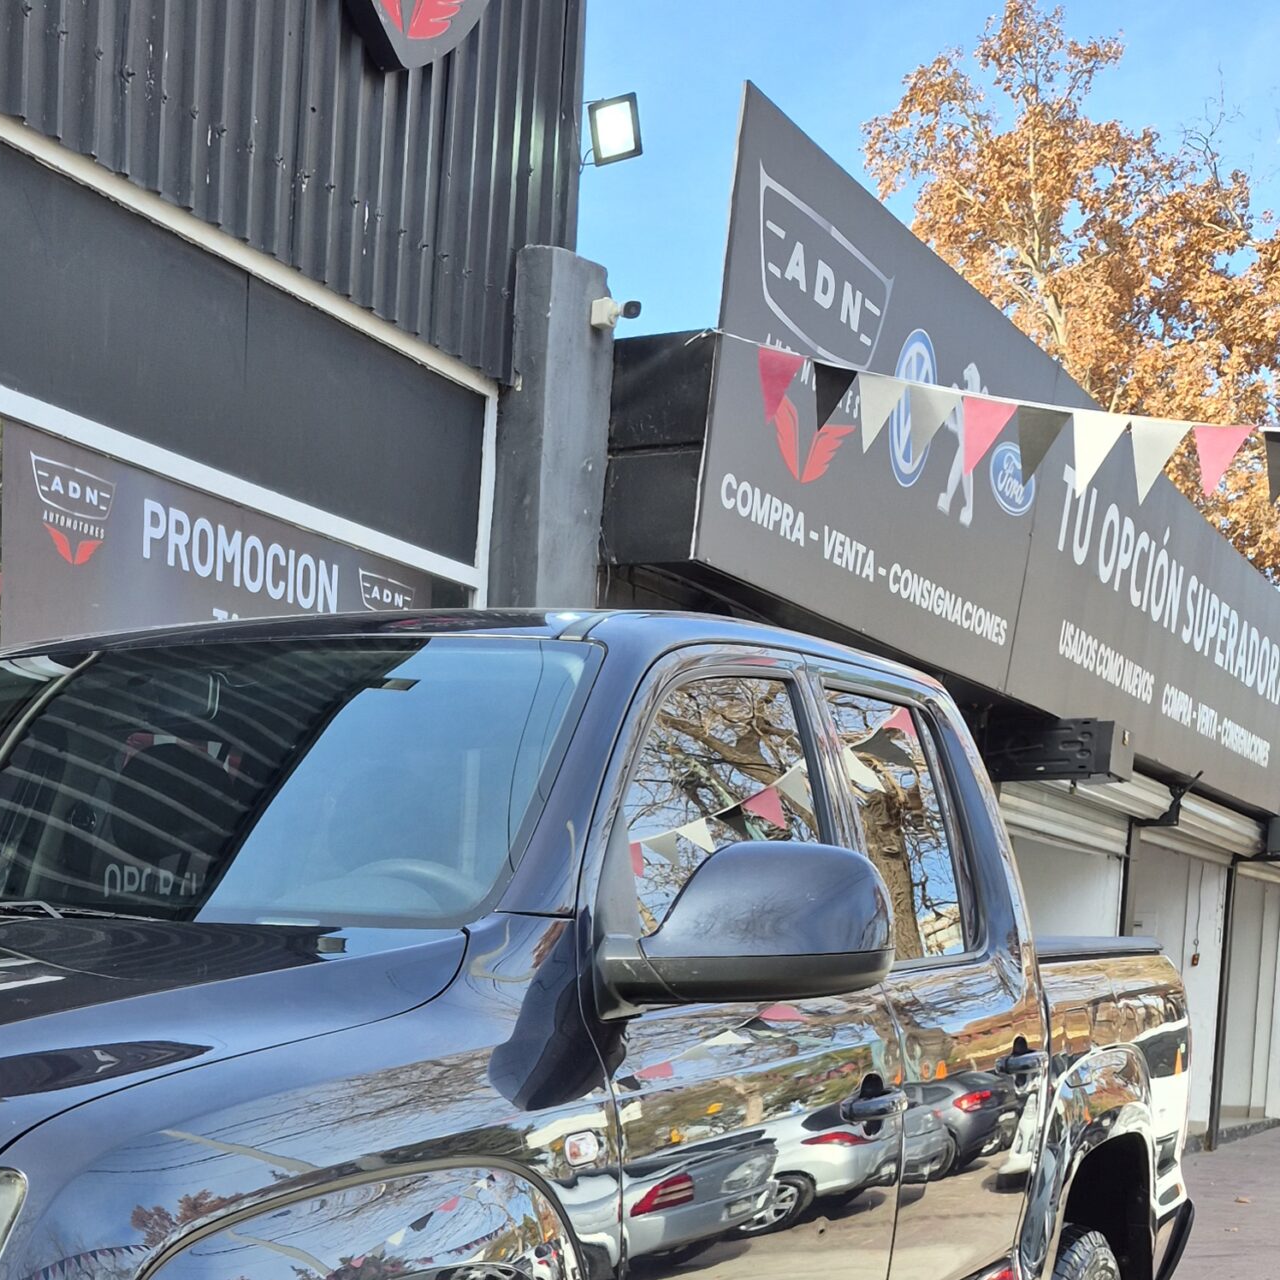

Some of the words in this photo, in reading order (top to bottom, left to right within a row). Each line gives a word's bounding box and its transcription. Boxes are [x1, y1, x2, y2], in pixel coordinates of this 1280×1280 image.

[784, 241, 862, 333] ADN
[42, 510, 105, 539] AUTOMOTORES
[50, 475, 99, 506] ADN
[142, 498, 339, 613] PROMOCION
[720, 473, 805, 547] COMPRA
[823, 525, 875, 582] VENTA
[888, 563, 1008, 647] CONSIGNACIONES
[1057, 464, 1098, 565] TU
[1098, 503, 1185, 633] OPCIÓN
[370, 584, 404, 608] ADN
[1058, 619, 1098, 672] USADOS
[1095, 642, 1125, 687] COMO
[1121, 658, 1155, 705] NUEVOS
[1161, 682, 1193, 728] COMPRA
[1196, 702, 1218, 741] VENTA
